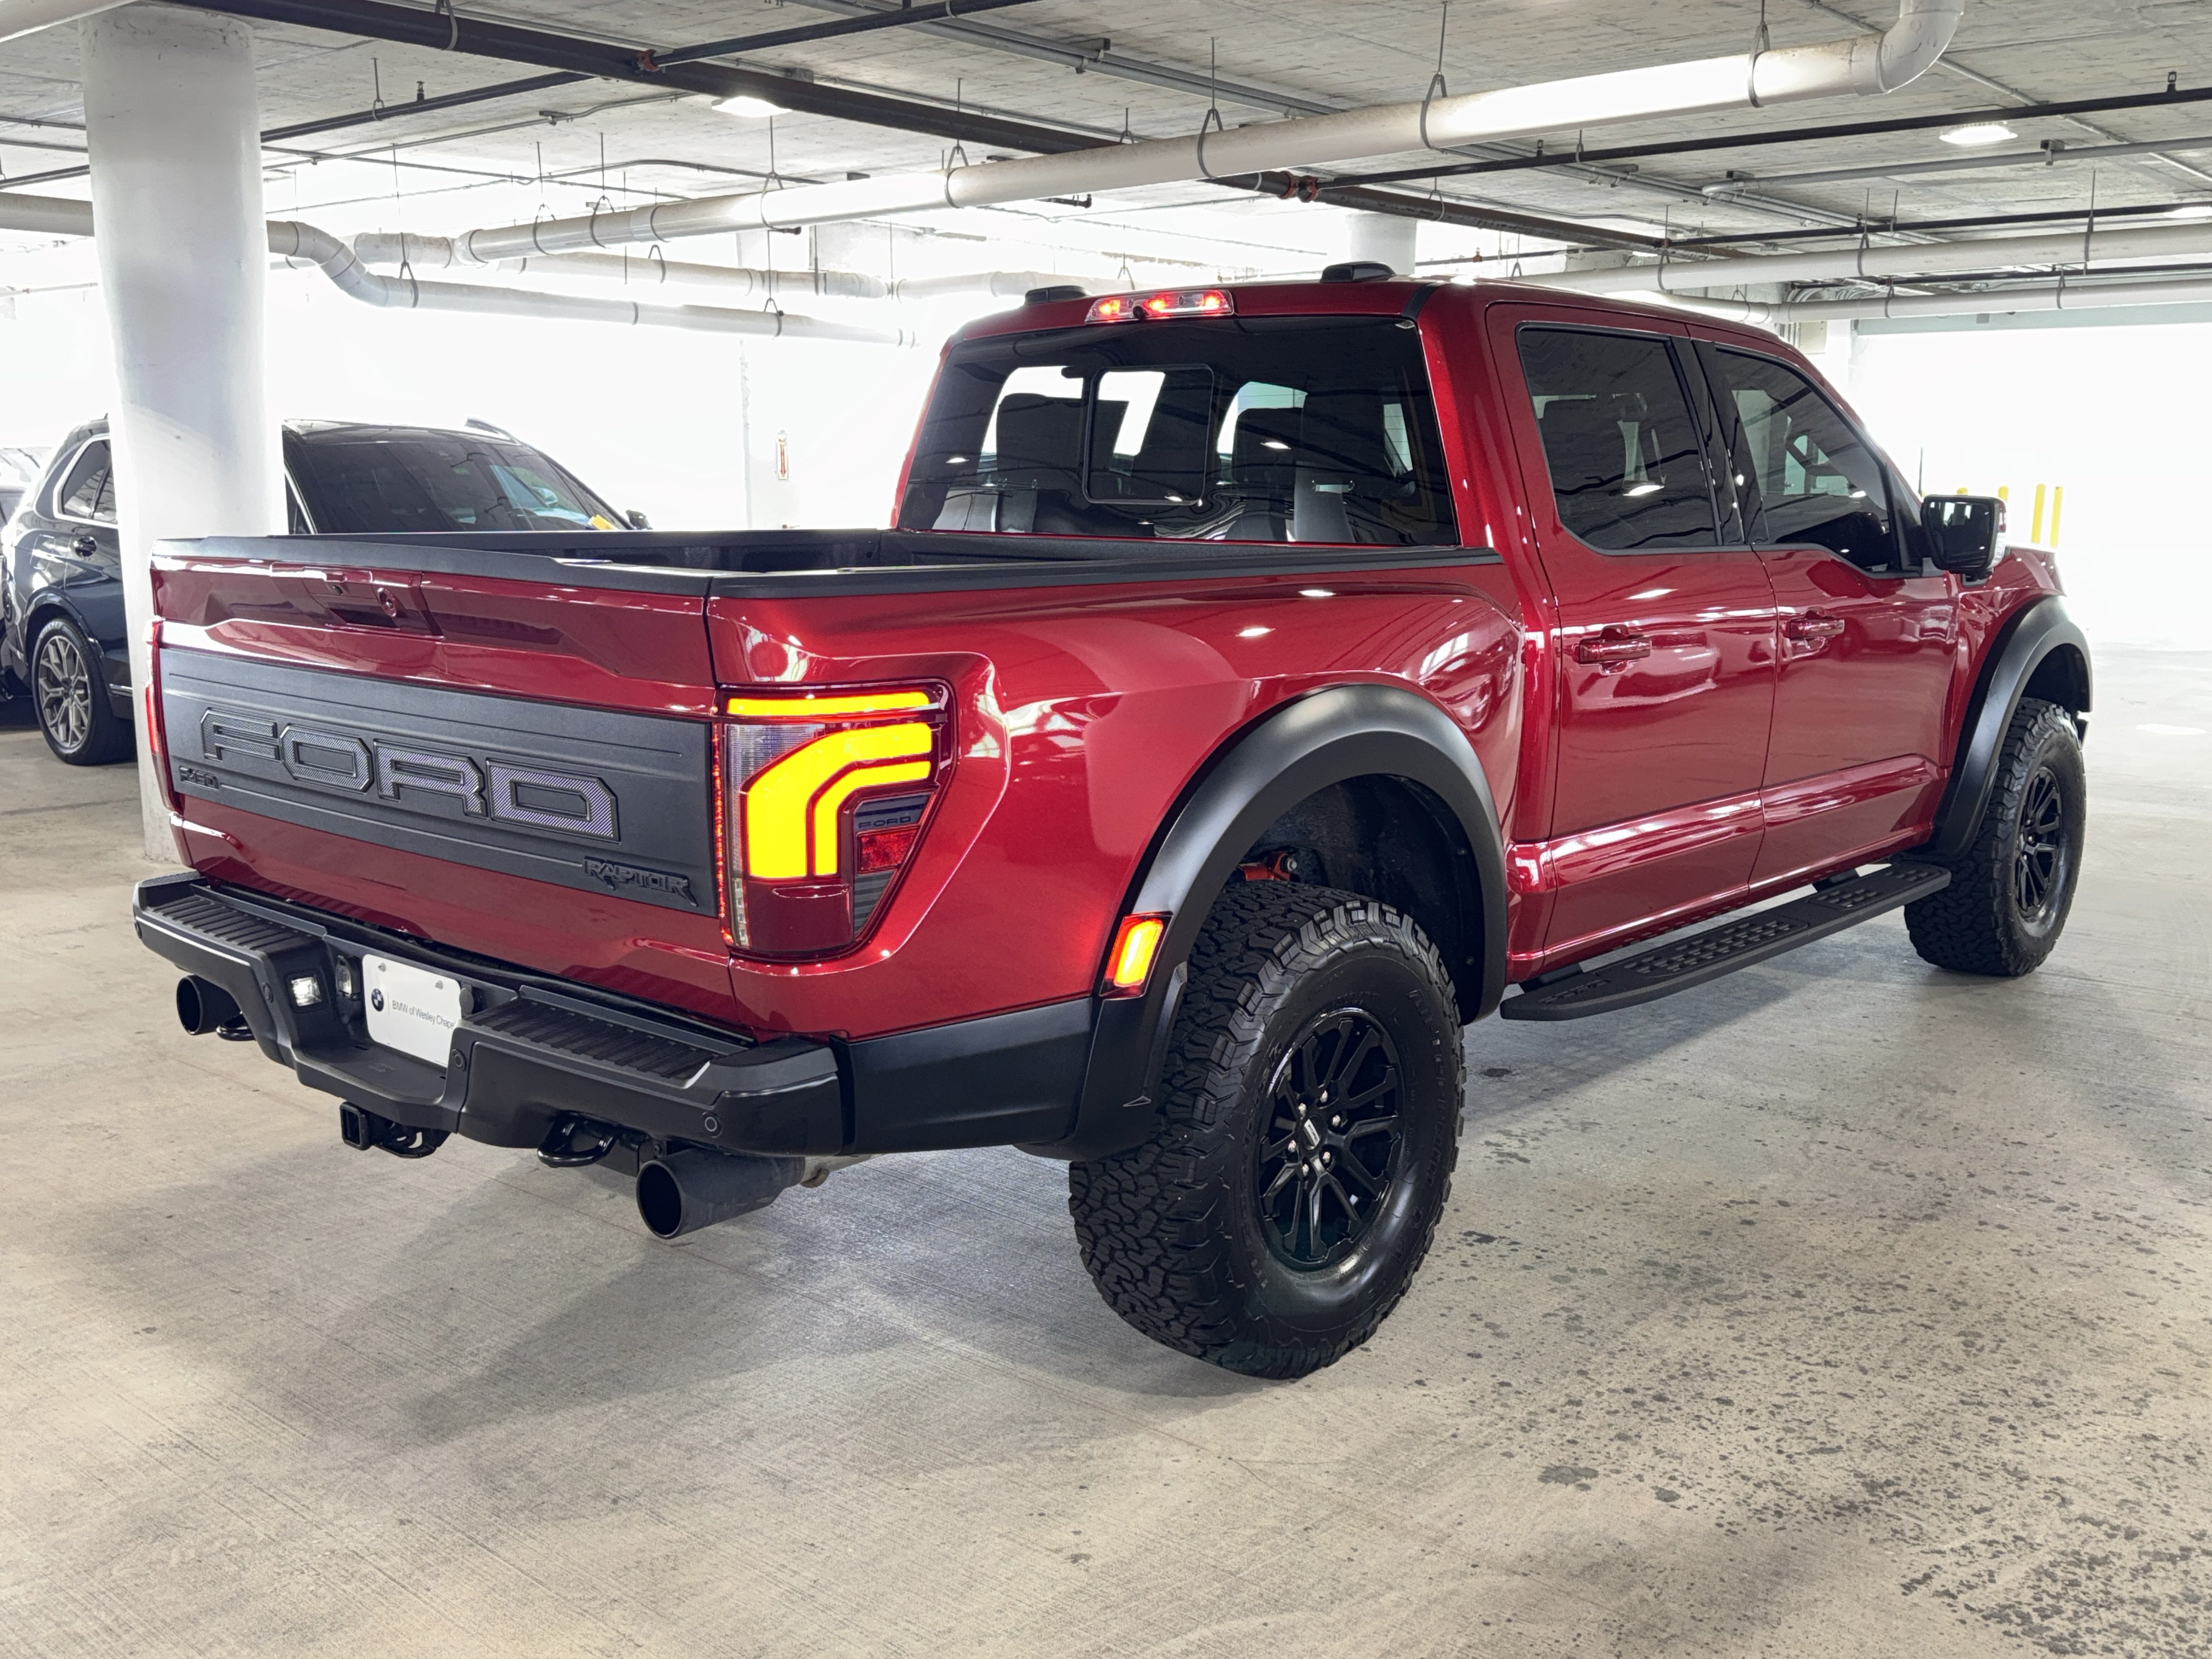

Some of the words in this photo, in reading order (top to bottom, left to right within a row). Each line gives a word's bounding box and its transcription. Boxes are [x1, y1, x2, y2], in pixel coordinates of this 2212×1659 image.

[201, 707, 621, 844] FORD
[859, 816, 911, 828] FORD
[583, 856, 699, 907] RAPTOR
[392, 1000, 408, 1013] BMW
[409, 1006, 415, 1015] of
[415, 1008, 436, 1025] Wesley
